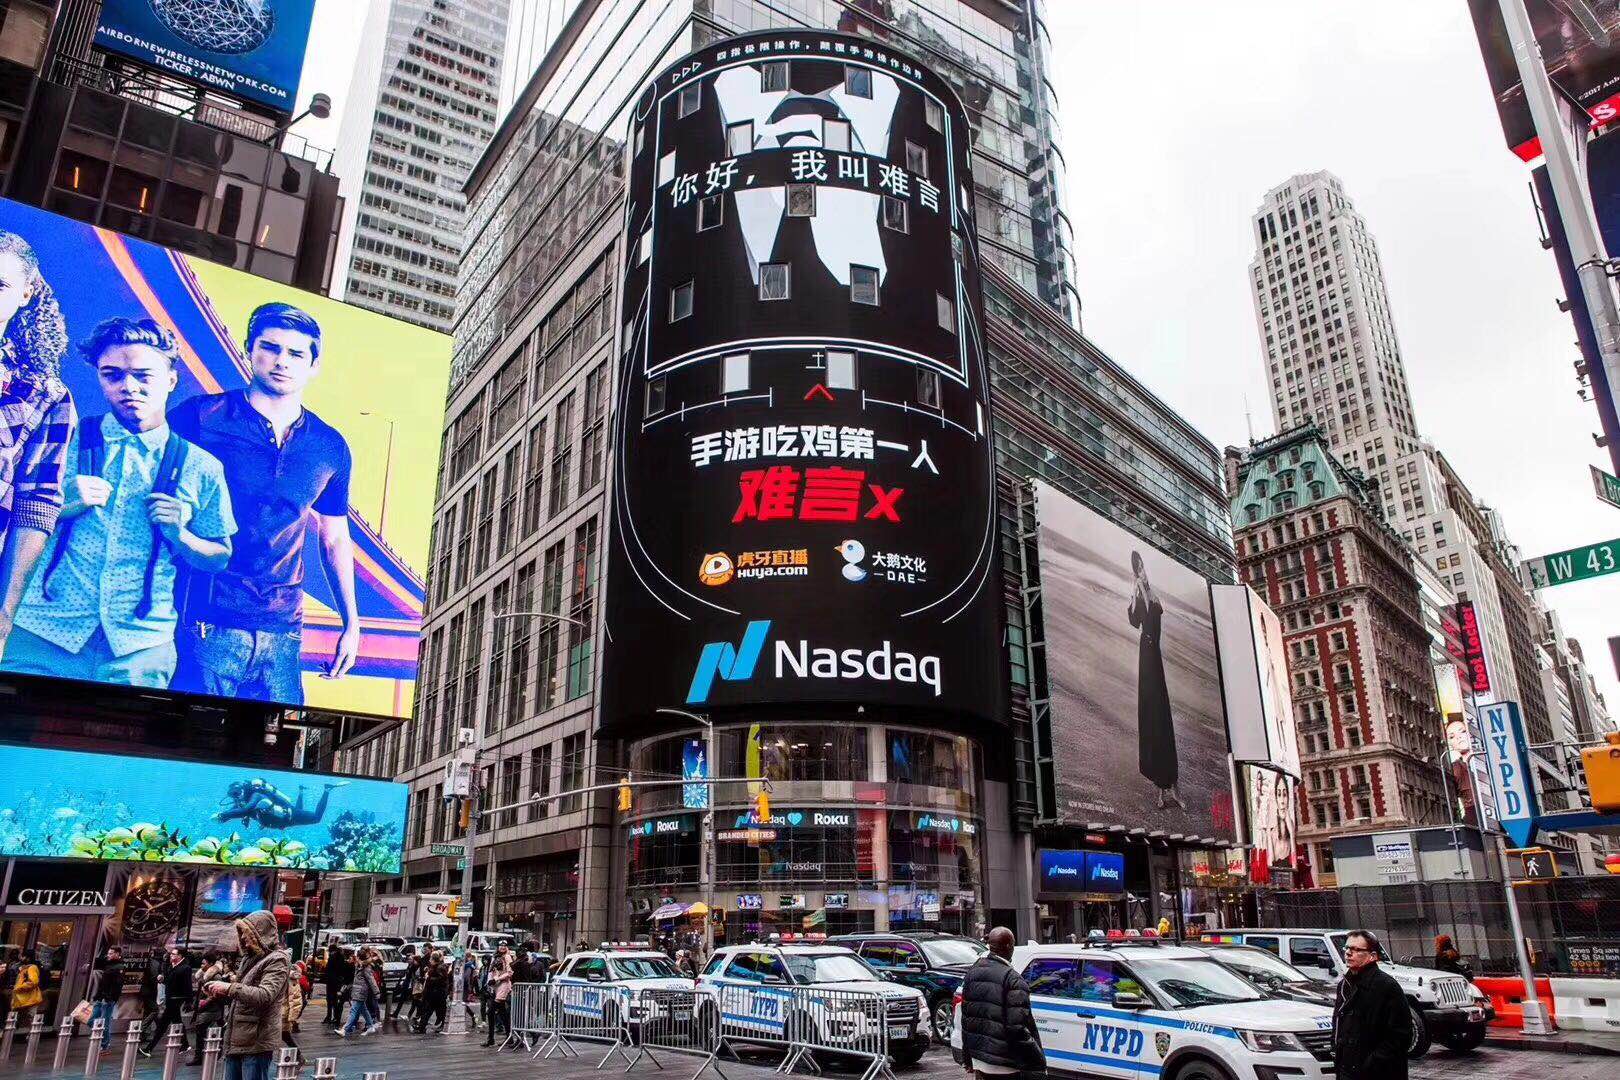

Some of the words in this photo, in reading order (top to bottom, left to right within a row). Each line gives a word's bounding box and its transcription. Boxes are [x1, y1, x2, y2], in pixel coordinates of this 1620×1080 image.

[98, 26, 287, 98] AIRBORNEWIRELESSNETWORK.COM
[155, 54, 192, 76] TICKER
[201, 73, 235, 91] ABWN
[670, 150, 940, 213] 你好，我叫难言
[691, 425, 939, 475] 手游吃鸡第一人
[737, 549, 808, 567] 虎牙直播
[872, 551, 926, 573] 大鹅文化
[1551, 555, 1573, 580] W
[1587, 545, 1615, 572] 43
[775, 640, 942, 696] Nasdaq
[1487, 708, 1521, 815] NYPD
[751, 814, 786, 826] Ndaq
[814, 813, 849, 825] Roku
[929, 817, 951, 830] Nasdaq
[432, 845, 462, 855] BROADWAY
[786, 861, 821, 872] Nasdaq
[1057, 867, 1077, 876] Nasdaq
[1100, 867, 1118, 880] Nasdaq
[18, 889, 110, 906] CITIZEN
[750, 996, 778, 1017] NYPD
[1184, 1021, 1214, 1034] POLICE
[1083, 1023, 1144, 1057] NYPD
